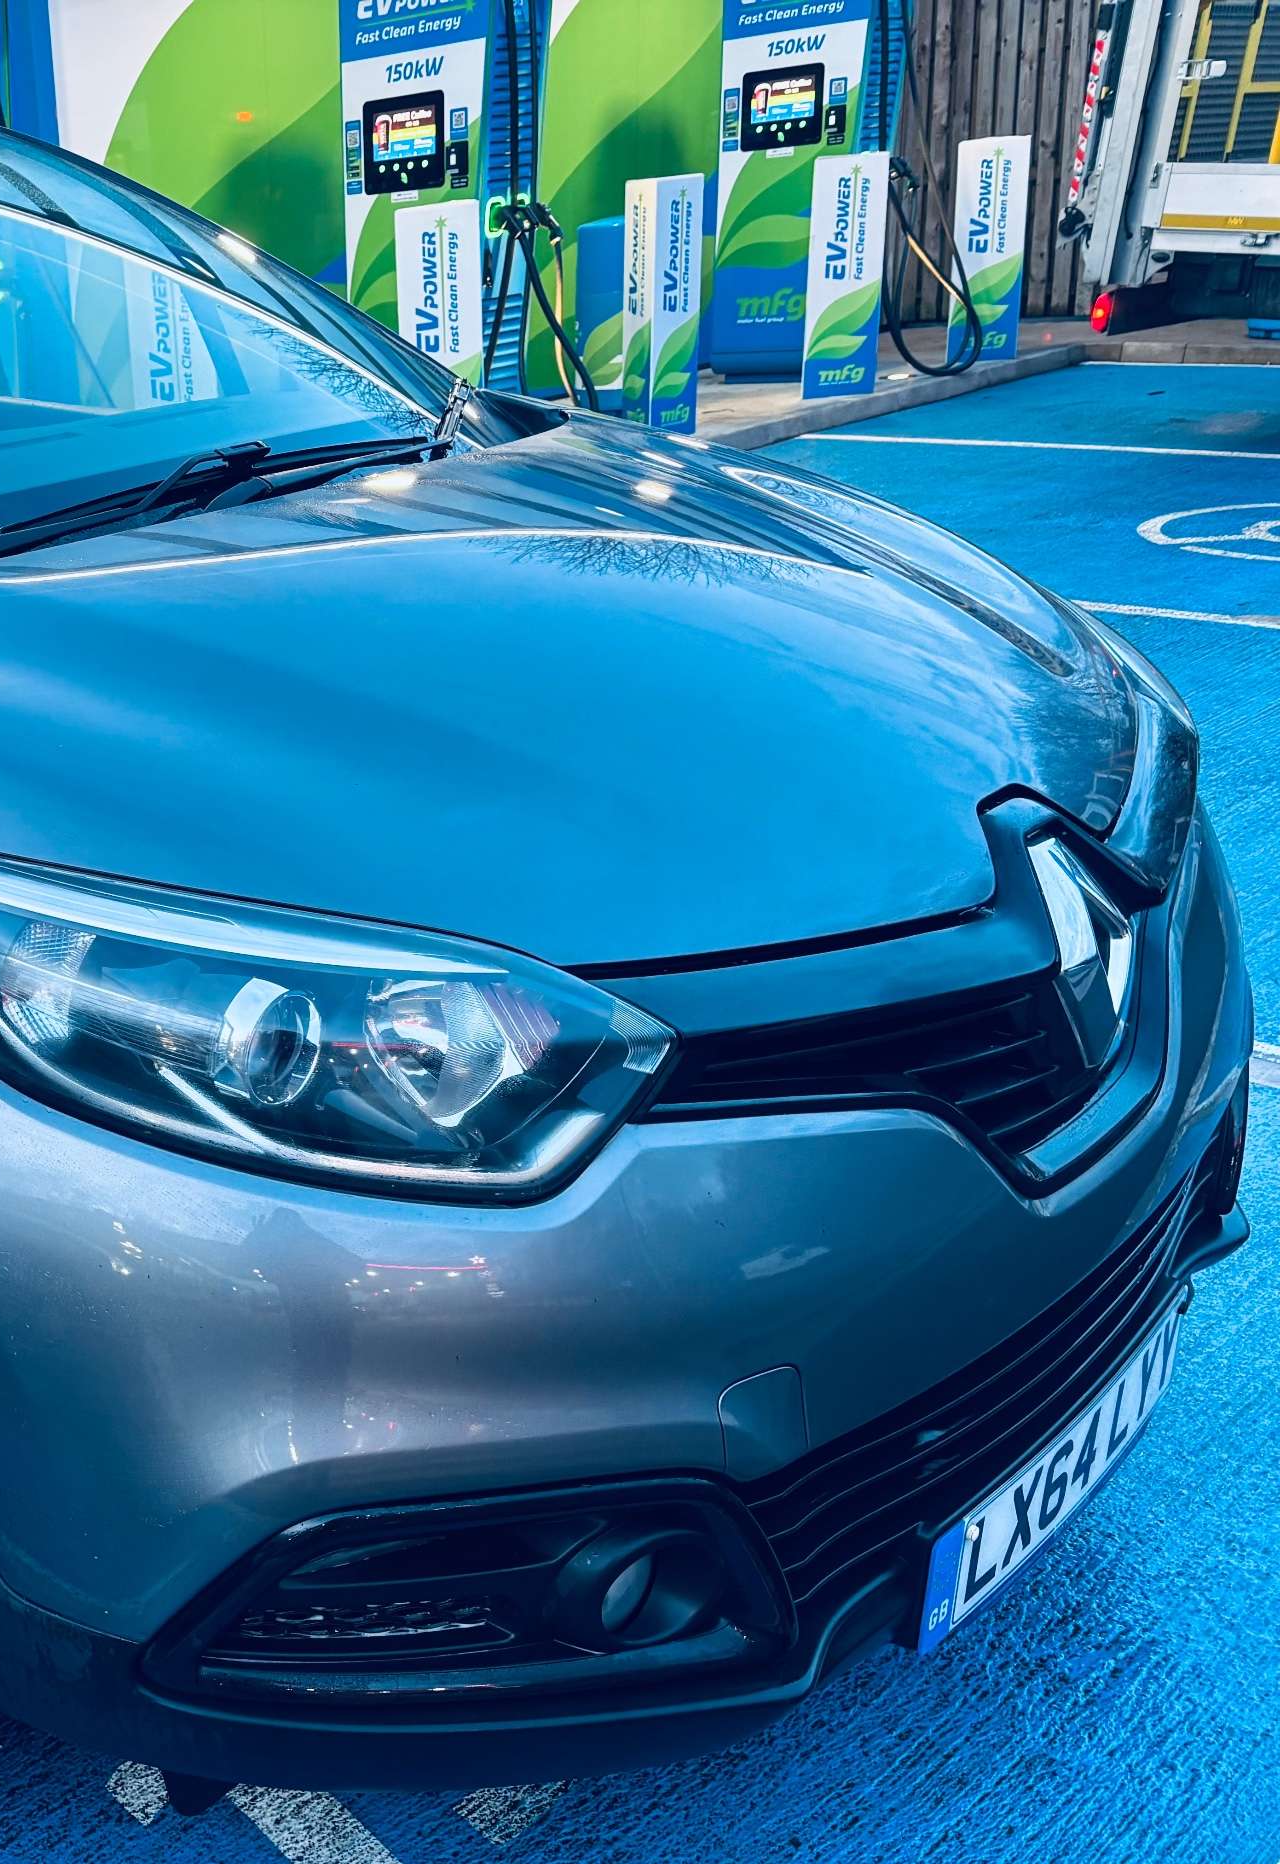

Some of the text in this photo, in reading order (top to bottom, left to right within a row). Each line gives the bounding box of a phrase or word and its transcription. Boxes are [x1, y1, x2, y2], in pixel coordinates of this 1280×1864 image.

[738, 0, 845, 26] Fast Clean Energy
[355, 15, 462, 46] Fast Clean Energy
[767, 33, 826, 57] 150kW
[385, 56, 444, 84] 150kW
[995, 159, 1011, 253] Fast Clean Energy
[853, 178, 870, 280] Fast Clean Energy
[681, 201, 692, 312] Fast Clean Energy
[446, 232, 460, 353] Fast Clean Energy
[736, 287, 805, 321] mfg
[182, 327, 192, 370] Clean
[818, 363, 865, 383] mfg
[660, 403, 690, 423] mfg
[963, 1405, 1103, 1605] LX64
[928, 1598, 949, 1631] GB
